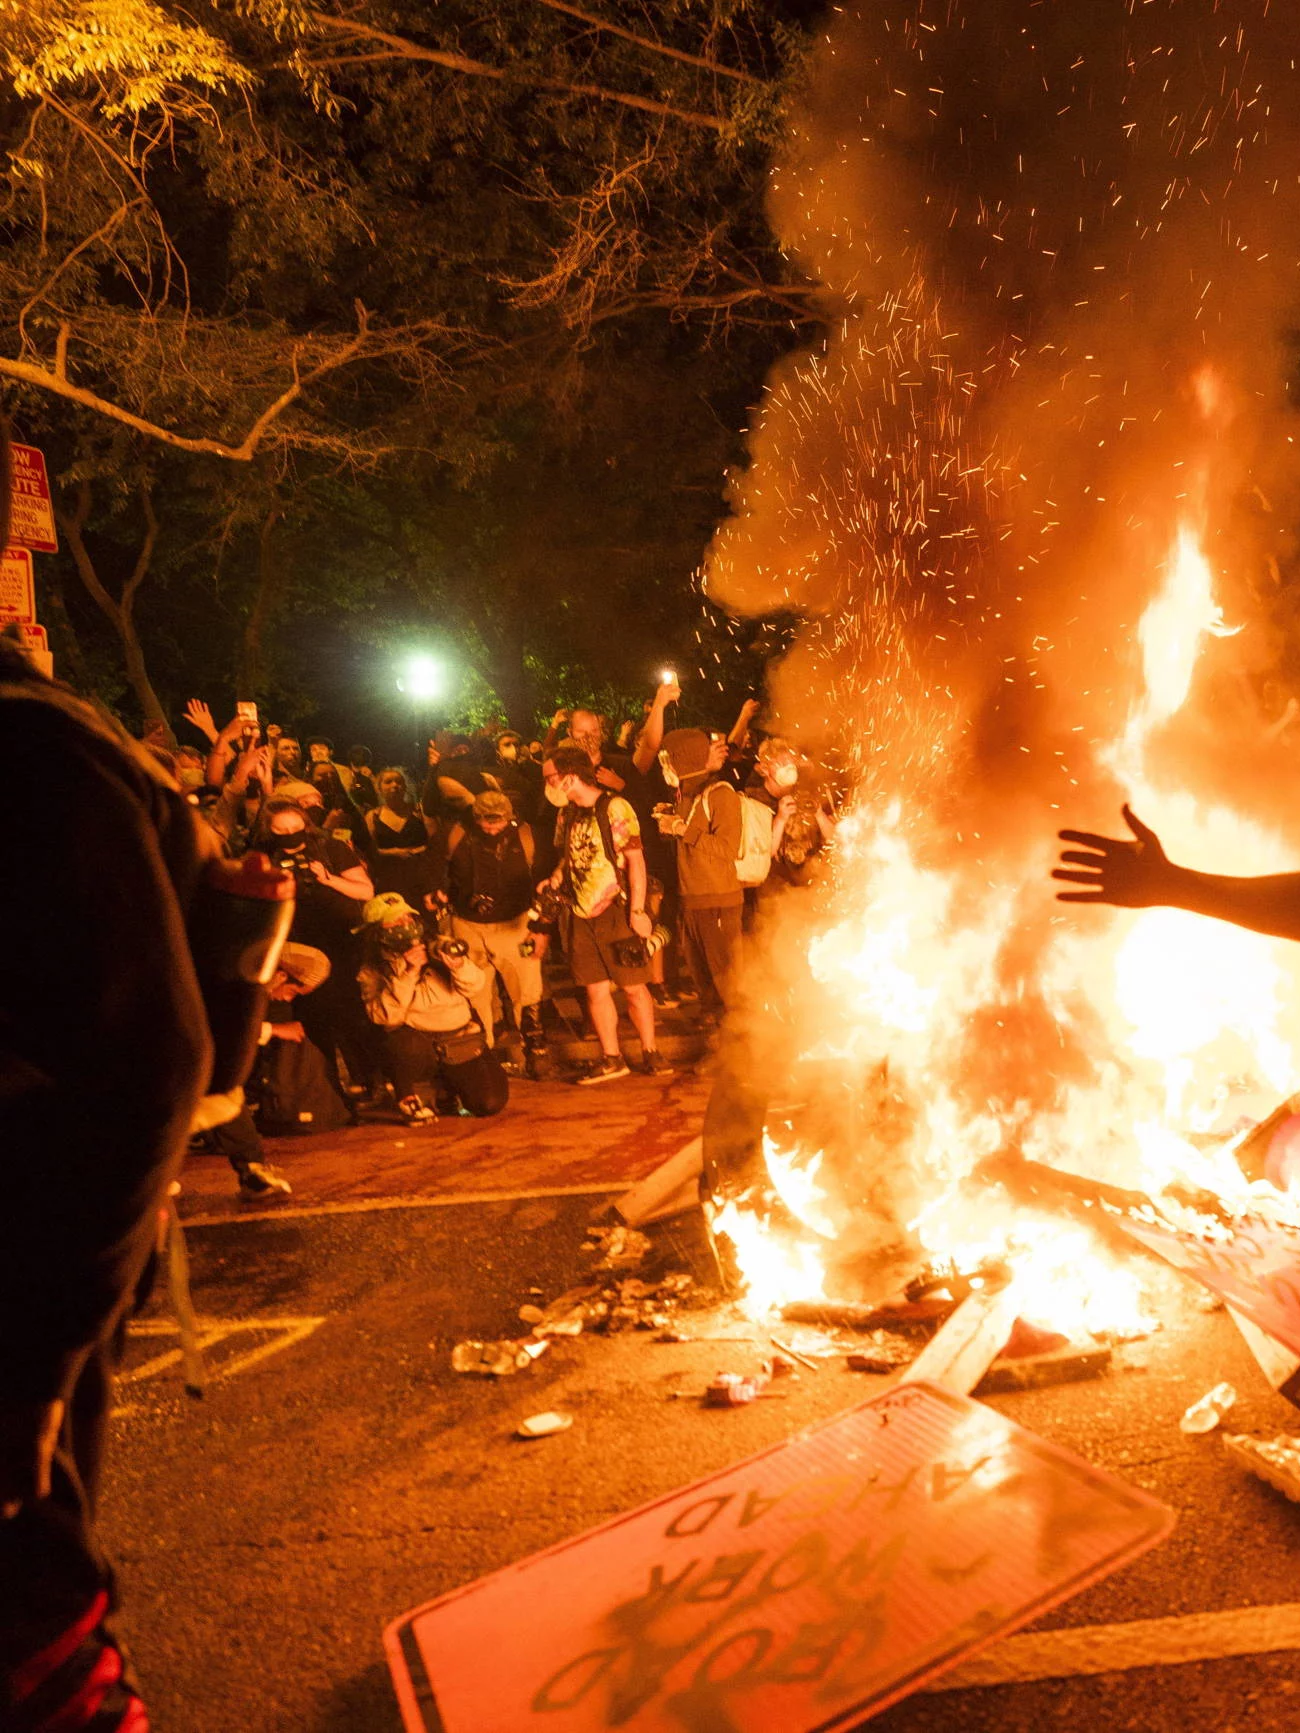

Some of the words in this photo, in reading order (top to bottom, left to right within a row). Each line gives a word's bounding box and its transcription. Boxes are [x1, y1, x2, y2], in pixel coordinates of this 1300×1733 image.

[11, 478, 42, 496] UTE
[664, 1456, 992, 1539] AHEAD
[636, 1530, 906, 1614] WORK
[531, 1620, 855, 1727] ROAD
